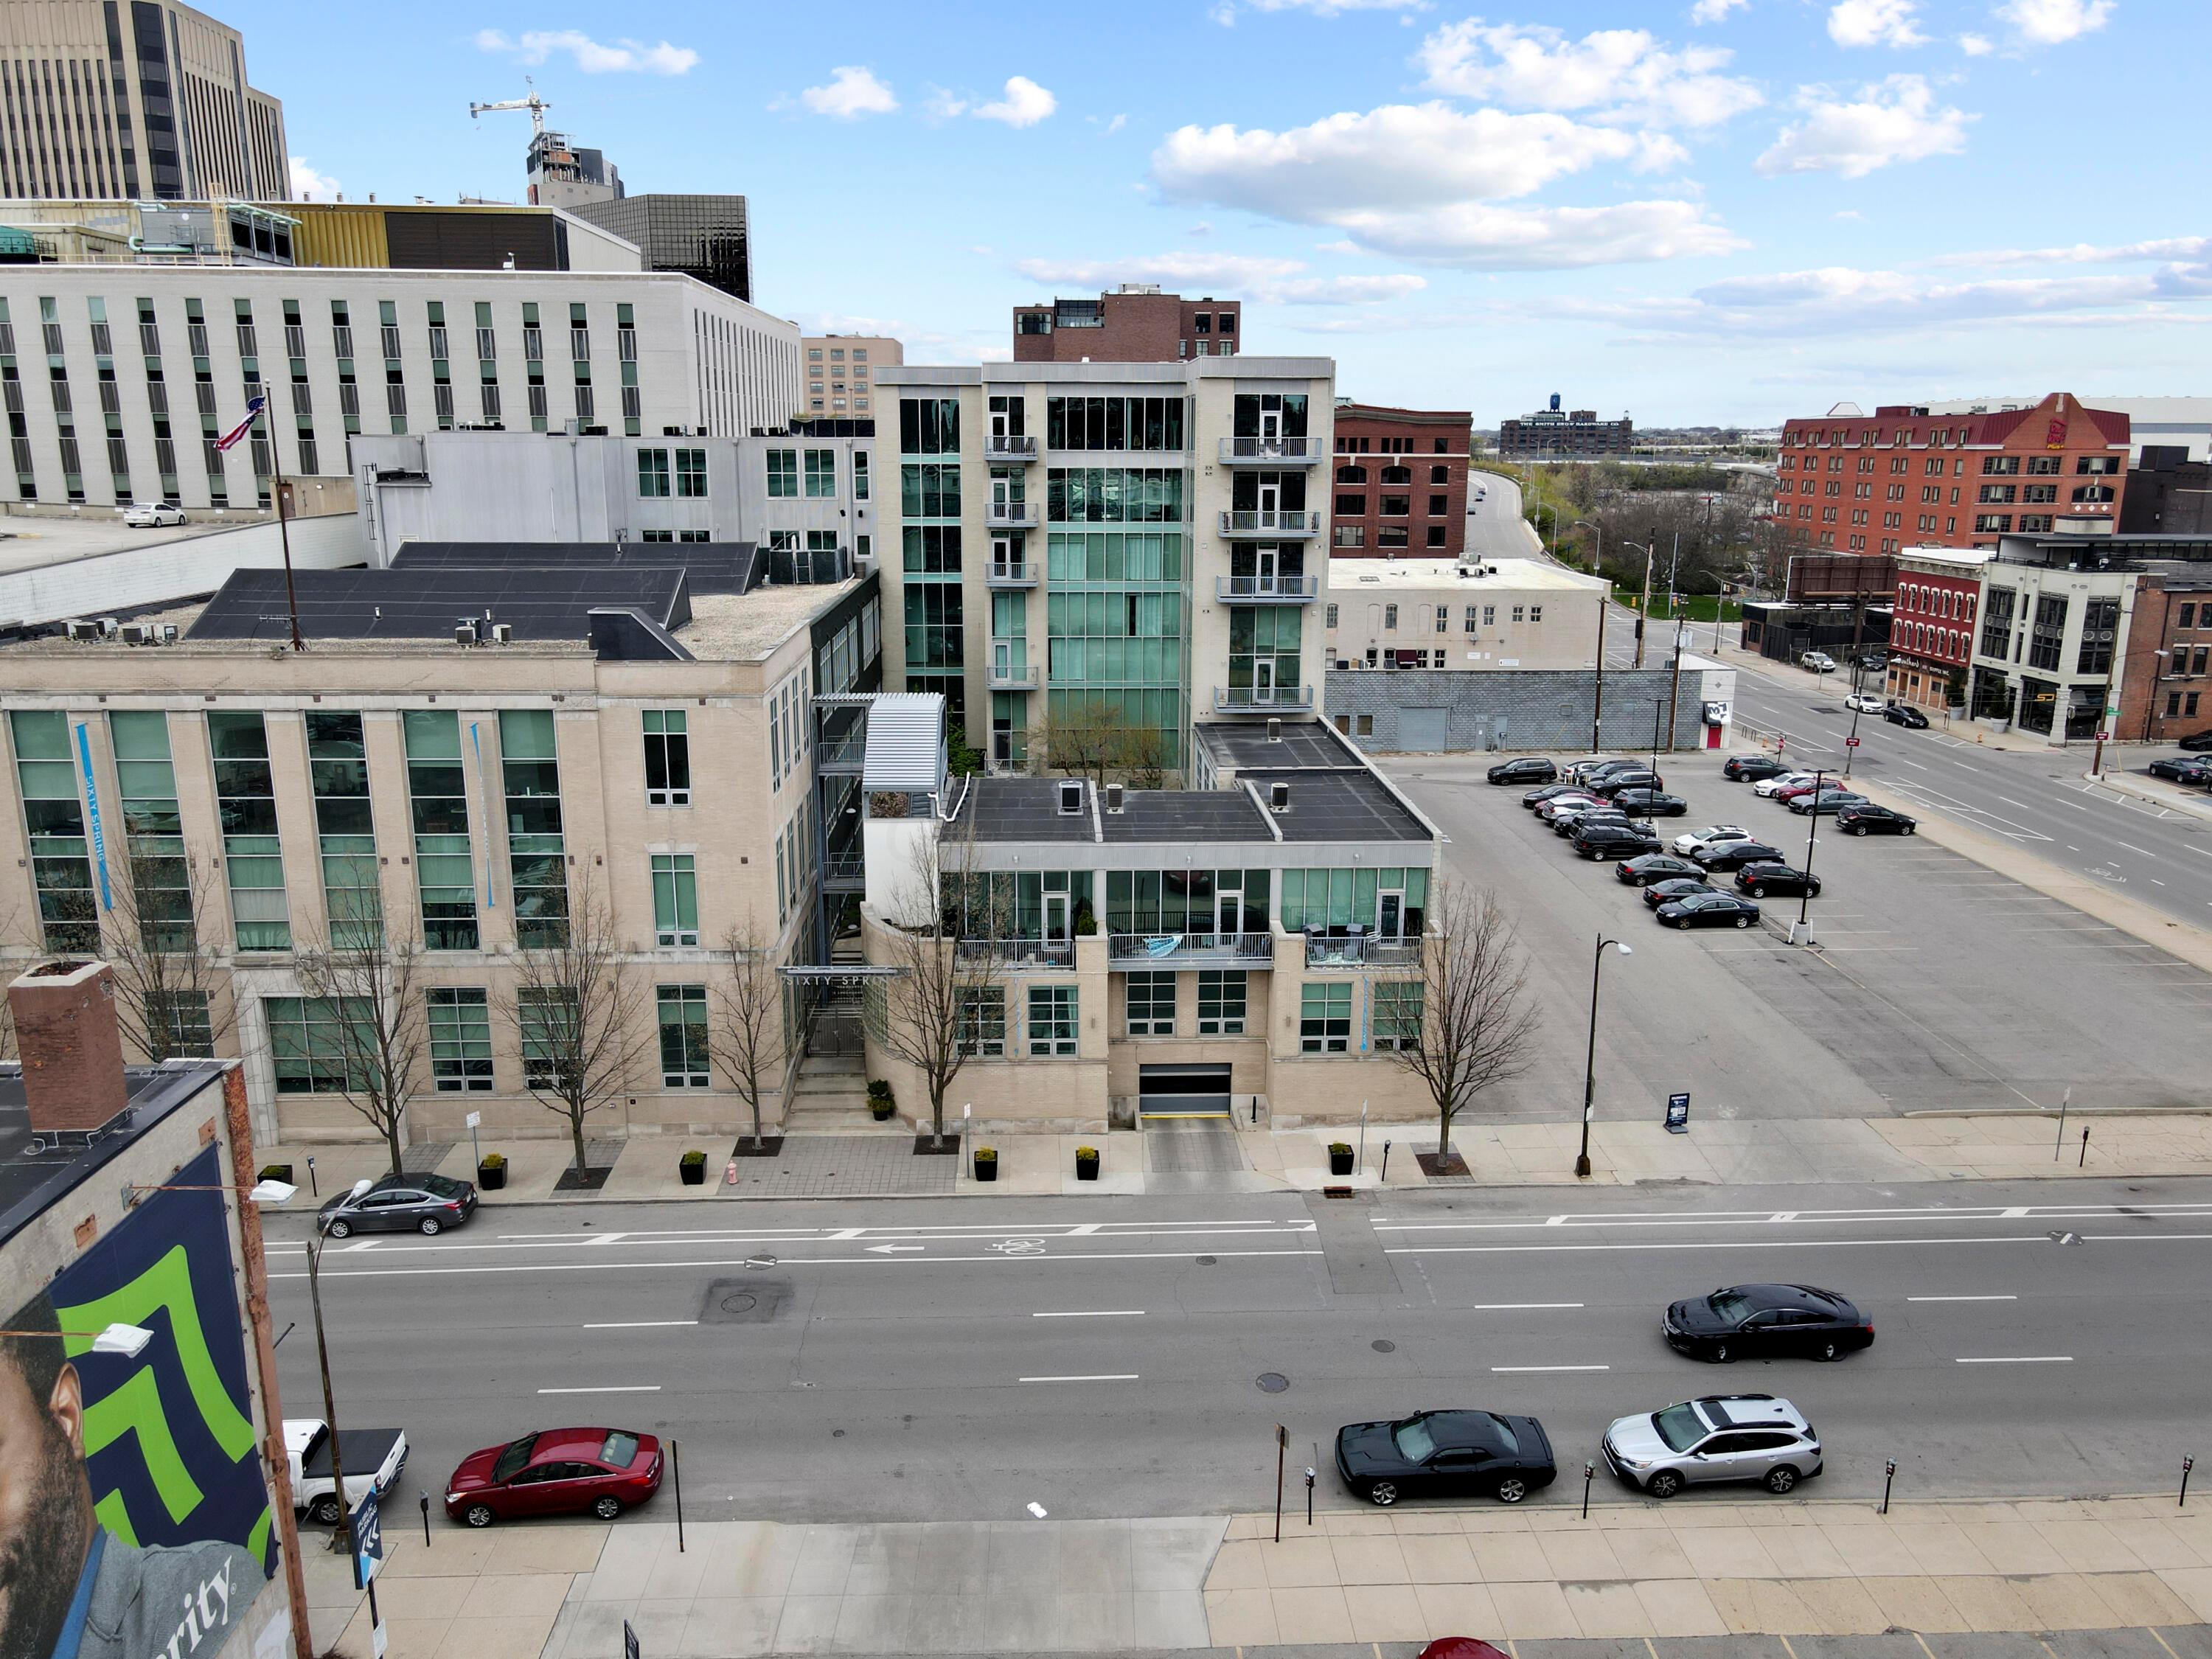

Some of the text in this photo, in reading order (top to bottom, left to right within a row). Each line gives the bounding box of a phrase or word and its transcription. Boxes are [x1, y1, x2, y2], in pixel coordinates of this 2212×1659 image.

[86, 776, 105, 861] SIXTY SPRING
[787, 976, 832, 986] SIXTY
[358, 1503, 372, 1530] PUBLIC
[358, 1504, 378, 1539] PARKING
